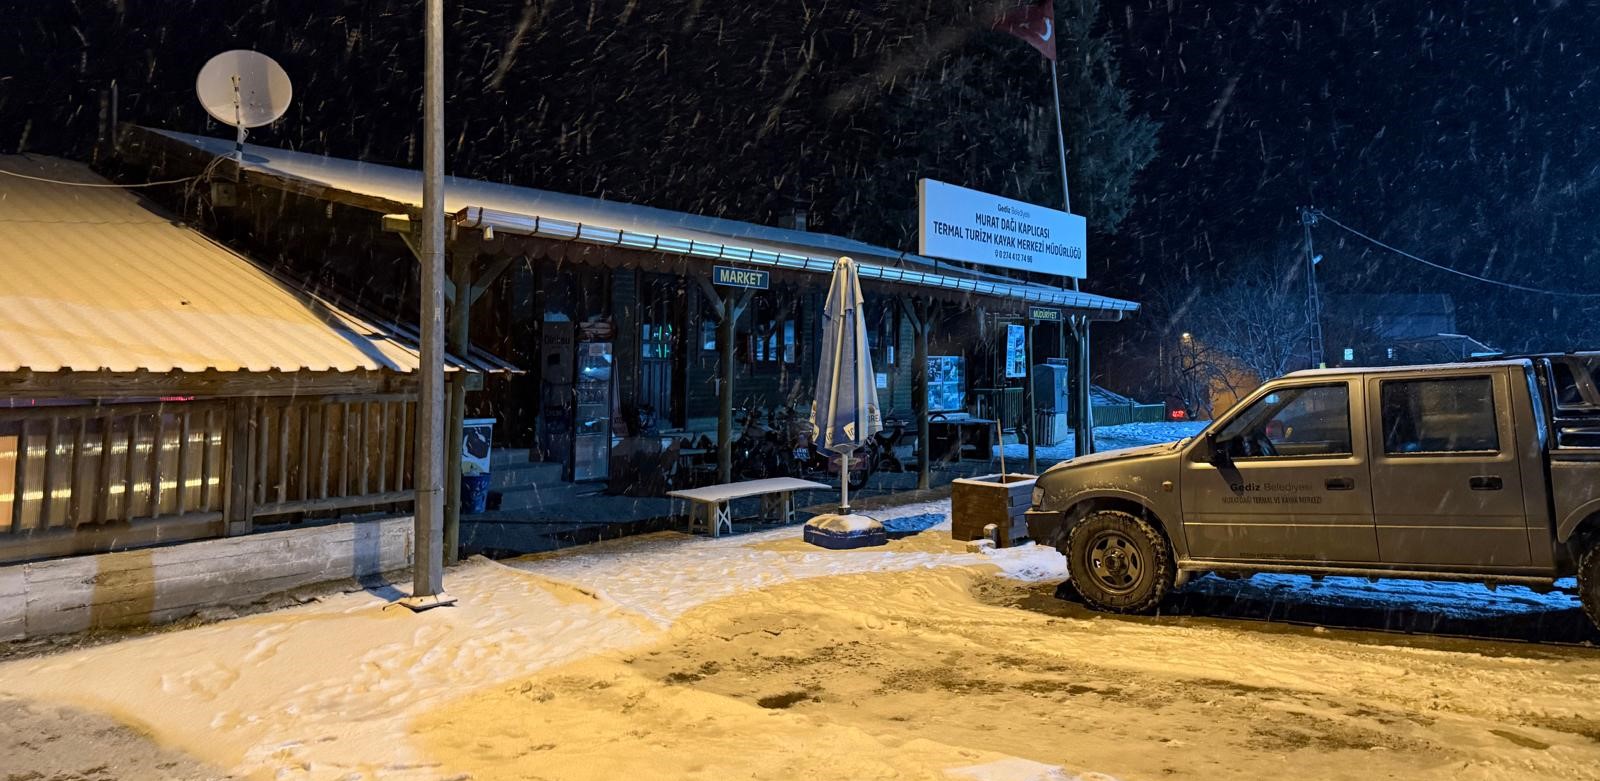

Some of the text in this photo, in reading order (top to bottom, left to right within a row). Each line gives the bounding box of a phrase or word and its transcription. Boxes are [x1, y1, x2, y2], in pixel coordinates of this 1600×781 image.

[997, 203, 1011, 214] Gediz
[975, 213, 1050, 239] MURAT DAĞI KAPLICASI
[933, 221, 1082, 260] TERMAL TURİZM KAYAK MERKEZİ MÜDÜRLÜĞÜ
[720, 269, 762, 286] MARKET
[1230, 482, 1261, 492] Gediz
